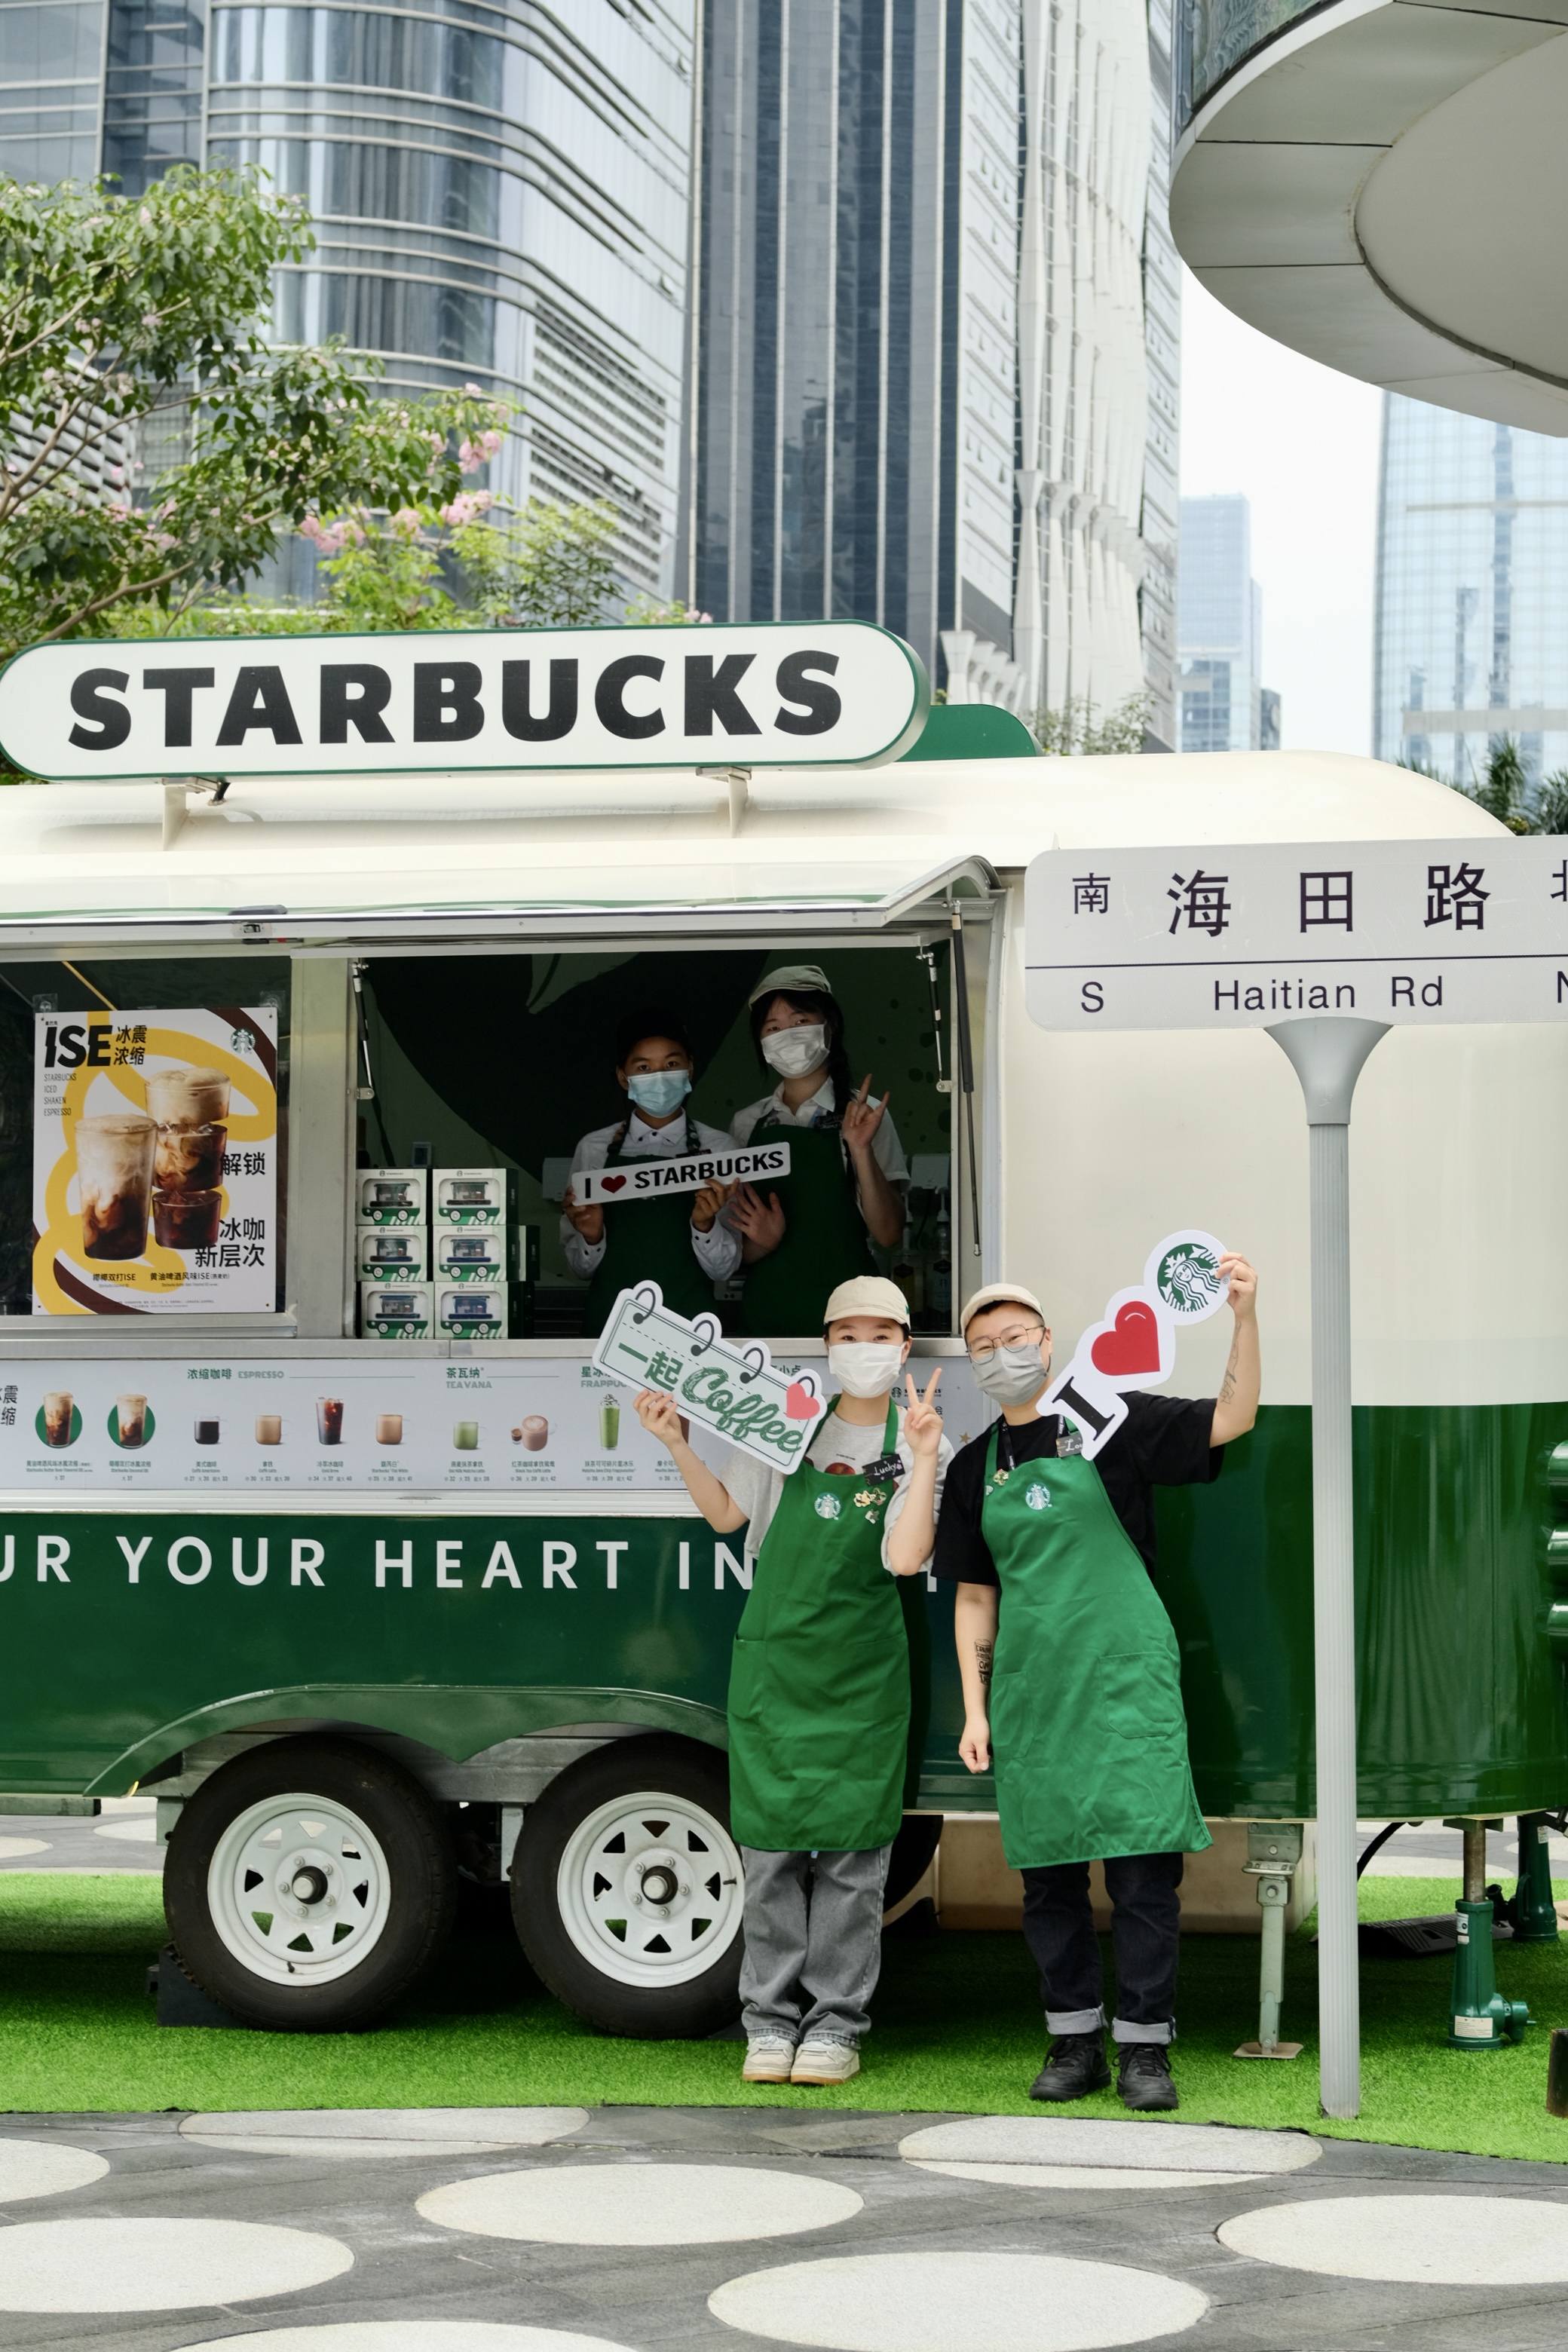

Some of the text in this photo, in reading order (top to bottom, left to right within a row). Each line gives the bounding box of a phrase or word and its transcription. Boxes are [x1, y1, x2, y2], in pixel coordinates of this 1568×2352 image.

[69, 650, 841, 751] STARBUCKS
[1072, 872, 1111, 914] 南
[1166, 859, 1491, 937] 海田路
[1081, 975, 1443, 1013] S Haitian Rd
[44, 1025, 113, 1067] ISE
[115, 1024, 147, 1044] 冰震
[113, 1046, 145, 1065] 浓缩
[44, 1073, 77, 1082] STARBUCKS
[44, 1085, 58, 1093] ICED
[44, 1096, 67, 1105] SHAKEN
[221, 1152, 265, 1176] 解锁
[584, 1150, 785, 1199] I STARBUCKS
[219, 1217, 265, 1241] 冰咖
[195, 1244, 265, 1268] 新层次
[187, 1368, 285, 1380] 浓缩咖啡 ESPRESSO
[446, 1380, 493, 1389] TEAVANA
[0, 1385, 19, 1404] 震
[680, 1366, 804, 1453] Coffee
[874, 1461, 897, 1477] Lucky
[115, 1536, 326, 1586] YOUR
[375, 1540, 629, 1588] HEART
